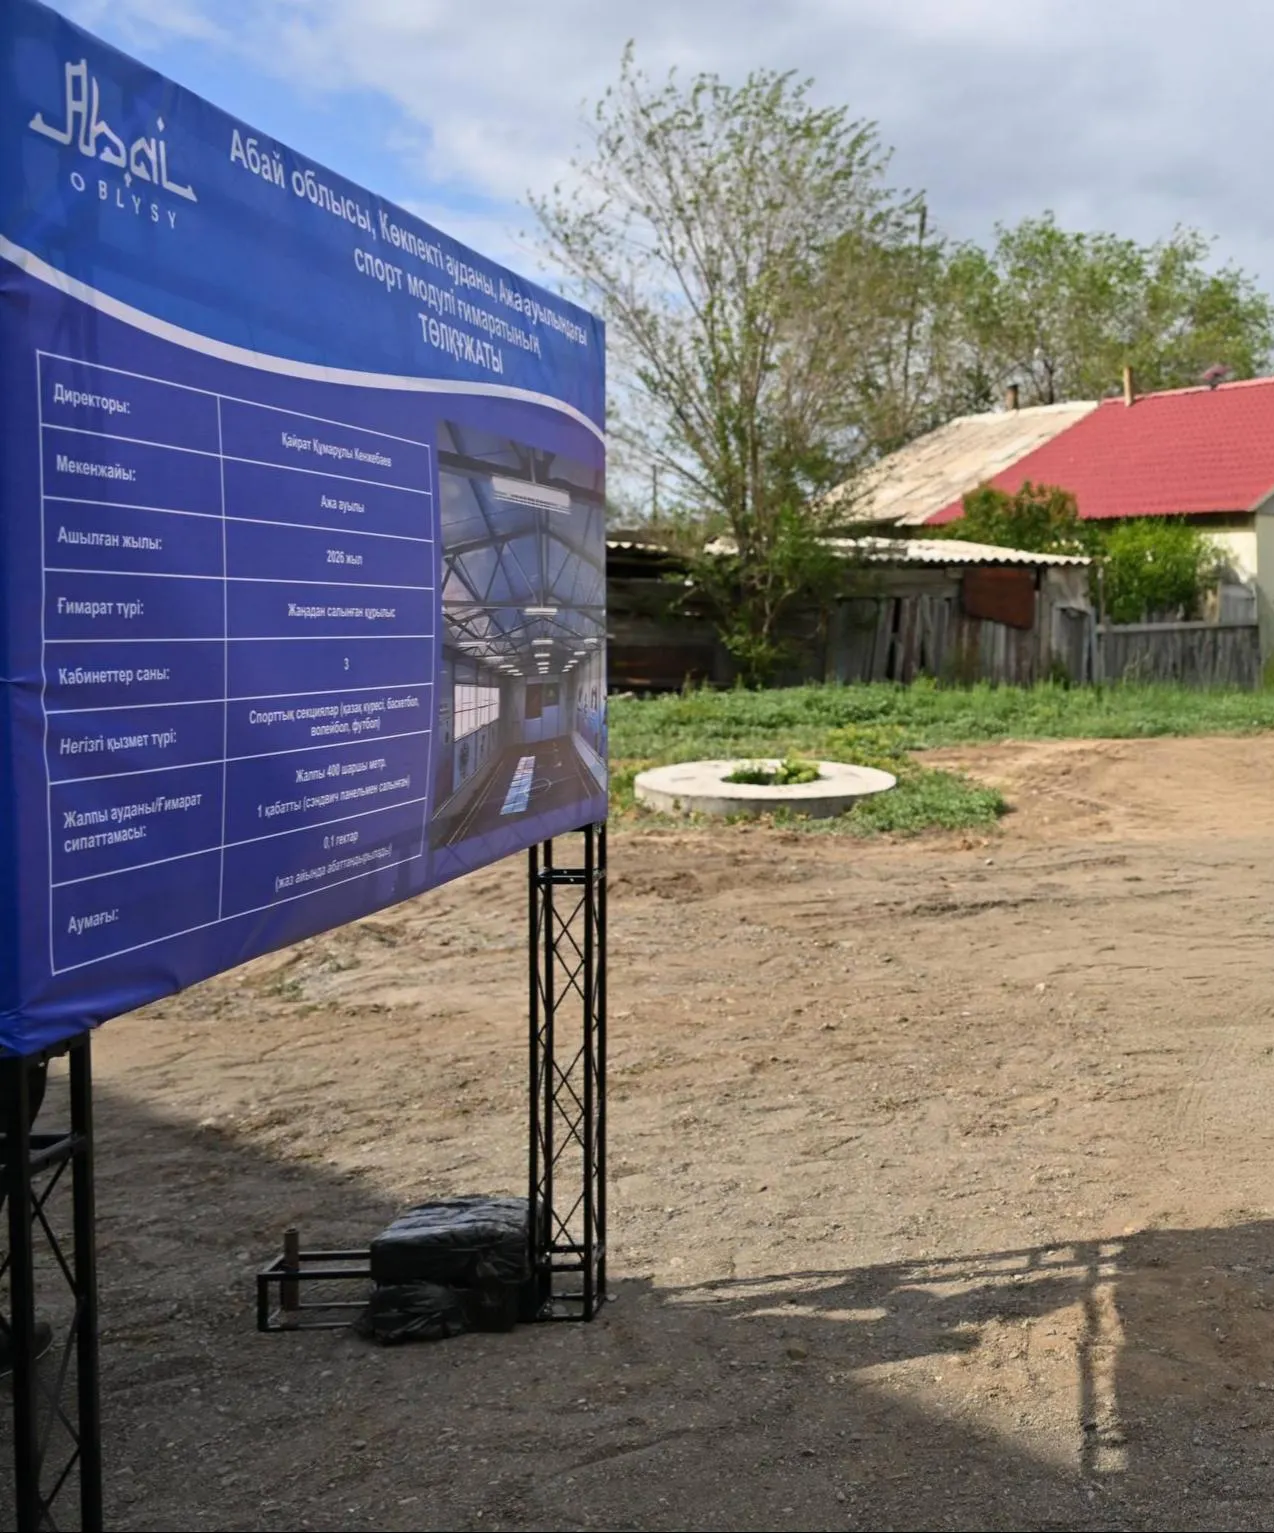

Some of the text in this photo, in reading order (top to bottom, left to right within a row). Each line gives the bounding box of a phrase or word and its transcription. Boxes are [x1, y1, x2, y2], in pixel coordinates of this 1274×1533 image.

[70, 171, 177, 229] OBLYSY
[230, 129, 285, 189] Абай
[291, 169, 377, 241] облысы,
[378, 209, 445, 271] Көкпекті
[446, 254, 499, 303] ауданы,
[353, 247, 542, 360] спорт модулі ғимаратының
[53, 382, 132, 415] Директоры:
[281, 431, 313, 451] Қайрат
[55, 454, 137, 481] Мекенжайы:
[320, 494, 365, 514] Ажа ауылы
[57, 525, 163, 550] Ашылған жылы:
[345, 554, 363, 565] жыл
[57, 596, 144, 619] Ғимарат түрі:
[287, 603, 396, 620] Жаңадан салынған құрылыс
[58, 667, 171, 686] Кабинеттер саны:
[343, 657, 350, 671] 3
[249, 709, 295, 726] Спорттық
[295, 704, 340, 721] секциялар
[340, 702, 363, 718] (қазақ
[310, 716, 381, 737] волейбол, футбол)
[59, 727, 177, 755] Негізгі қызмет түрі:
[295, 768, 326, 784] Жалпы
[326, 763, 341, 777] 400
[341, 762, 369, 776] шаршы
[256, 804, 263, 818] 1
[263, 798, 302, 819] қабатты
[339, 785, 380, 801] панельмен
[379, 774, 411, 793] салынған)
[63, 793, 203, 830] Жалпы ауданы/Ғимарат
[63, 825, 148, 854] сипаттамасы:
[335, 831, 359, 846] гектар
[274, 875, 295, 894] (жаз
[294, 868, 327, 884] айында
[67, 908, 121, 936] Аумағы:
